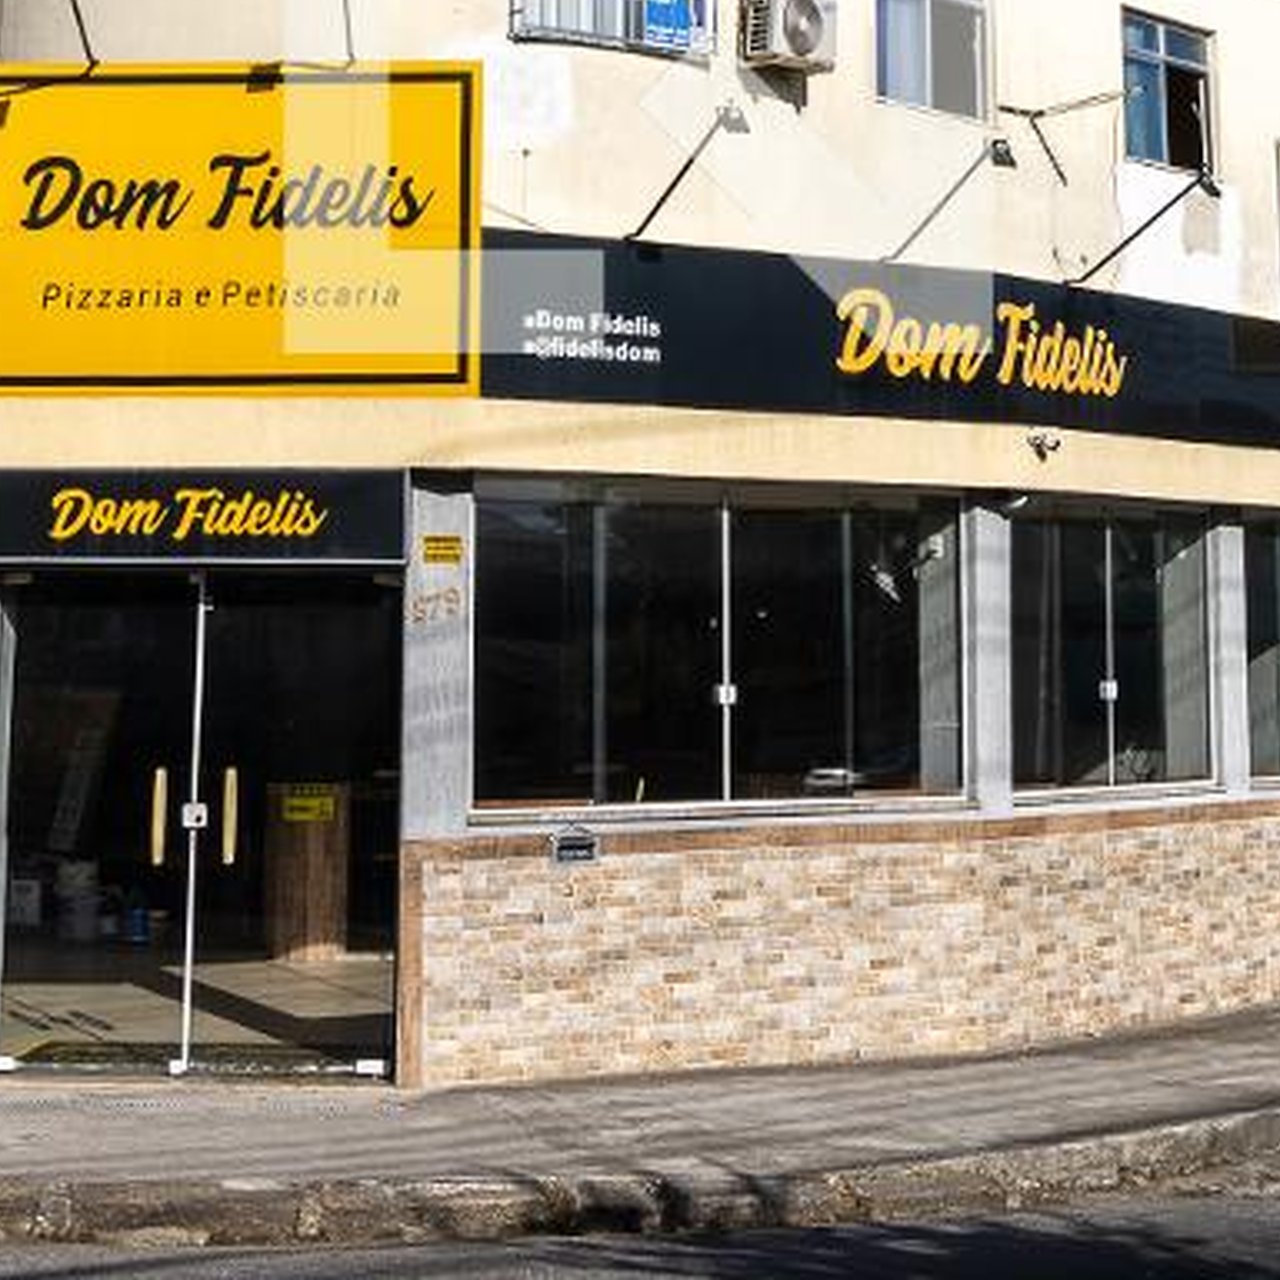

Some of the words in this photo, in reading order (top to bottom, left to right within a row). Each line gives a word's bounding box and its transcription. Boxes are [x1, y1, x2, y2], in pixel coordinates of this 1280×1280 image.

[22, 156, 193, 231] Dom
[207, 150, 434, 230] Fidelis
[41, 281, 183, 311] Pizzaria
[194, 288, 212, 309] e
[220, 280, 401, 309] Petiscaria
[535, 309, 586, 332] Dom
[589, 311, 662, 338] Fidelis
[835, 287, 993, 384] Dom
[996, 302, 1128, 398] Fidelis
[48, 487, 169, 541] Dom
[171, 486, 328, 541] Fidelis
